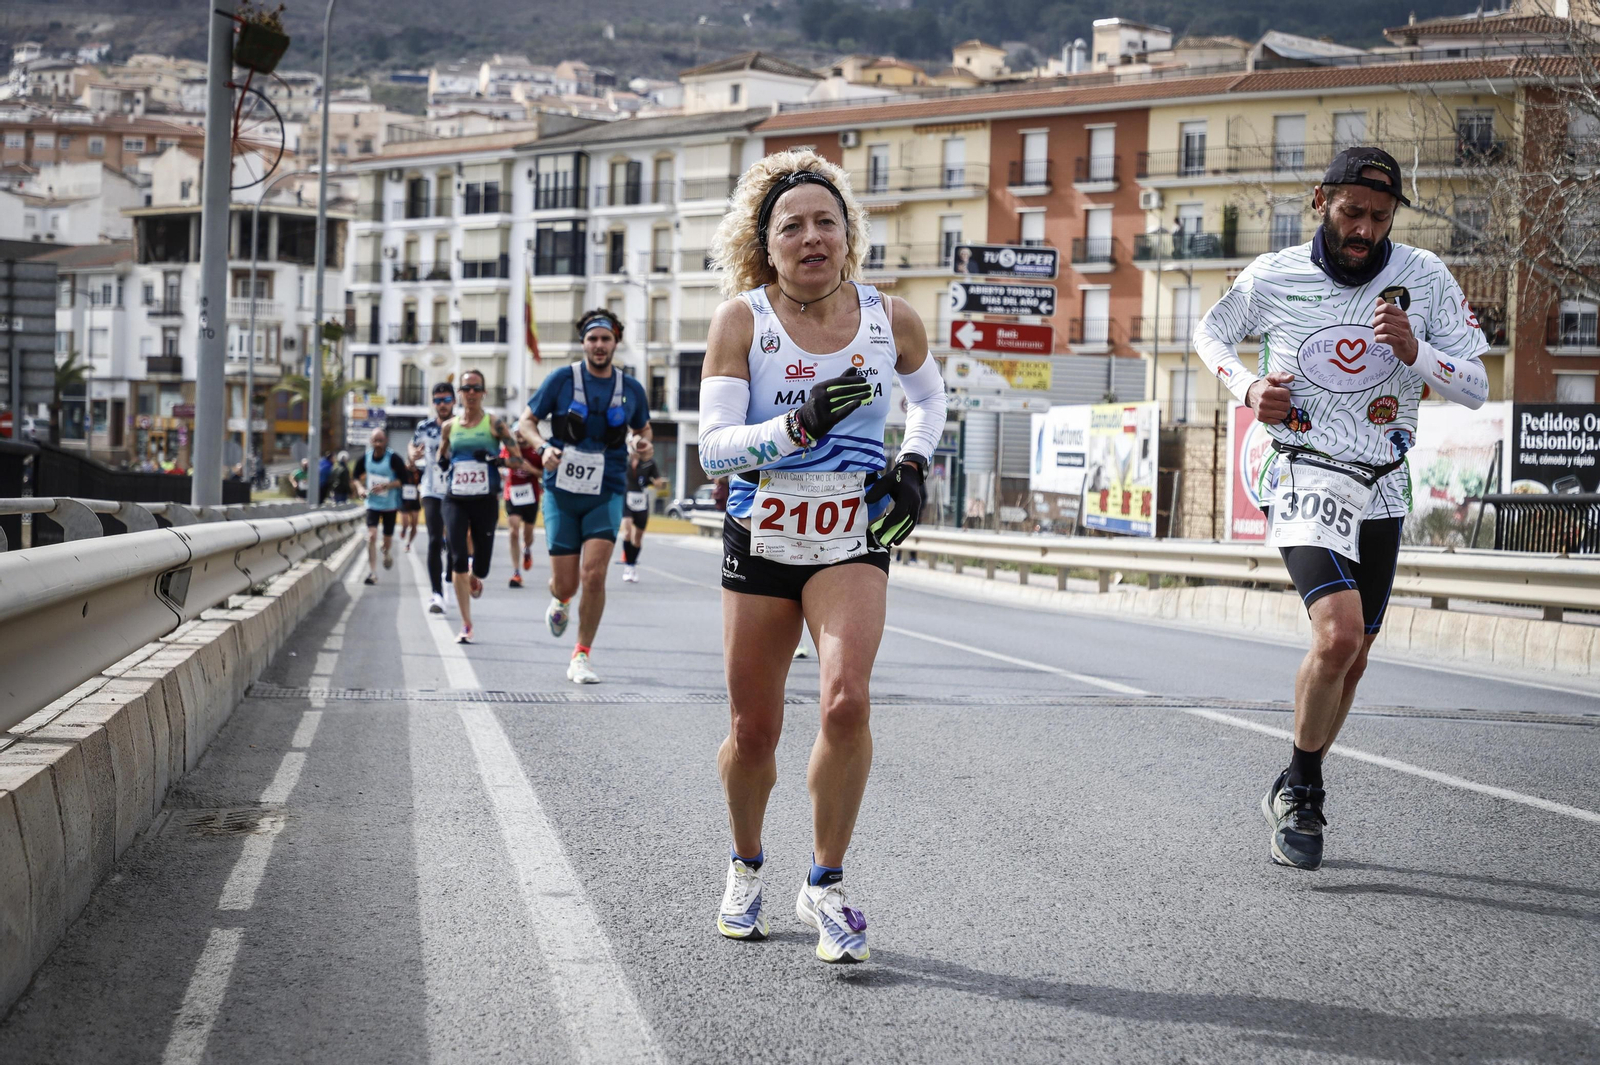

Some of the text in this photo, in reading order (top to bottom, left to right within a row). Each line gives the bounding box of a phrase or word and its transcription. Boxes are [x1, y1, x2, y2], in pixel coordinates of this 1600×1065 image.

[968, 286, 1052, 298] ABIERTO TODOS LOS
[1002, 296, 1018, 306] DEL
[1019, 296, 1040, 307] AÑO
[1521, 411, 1580, 432] Pedidos
[1519, 430, 1600, 455] fusionloja.
[1539, 453, 1567, 466] cómodo
[1567, 456, 1573, 468] y
[1573, 454, 1596, 468] rápido
[455, 472, 486, 485] 2023
[565, 463, 596, 481] 897
[759, 497, 861, 535] 2107
[1280, 492, 1353, 537] 3095
